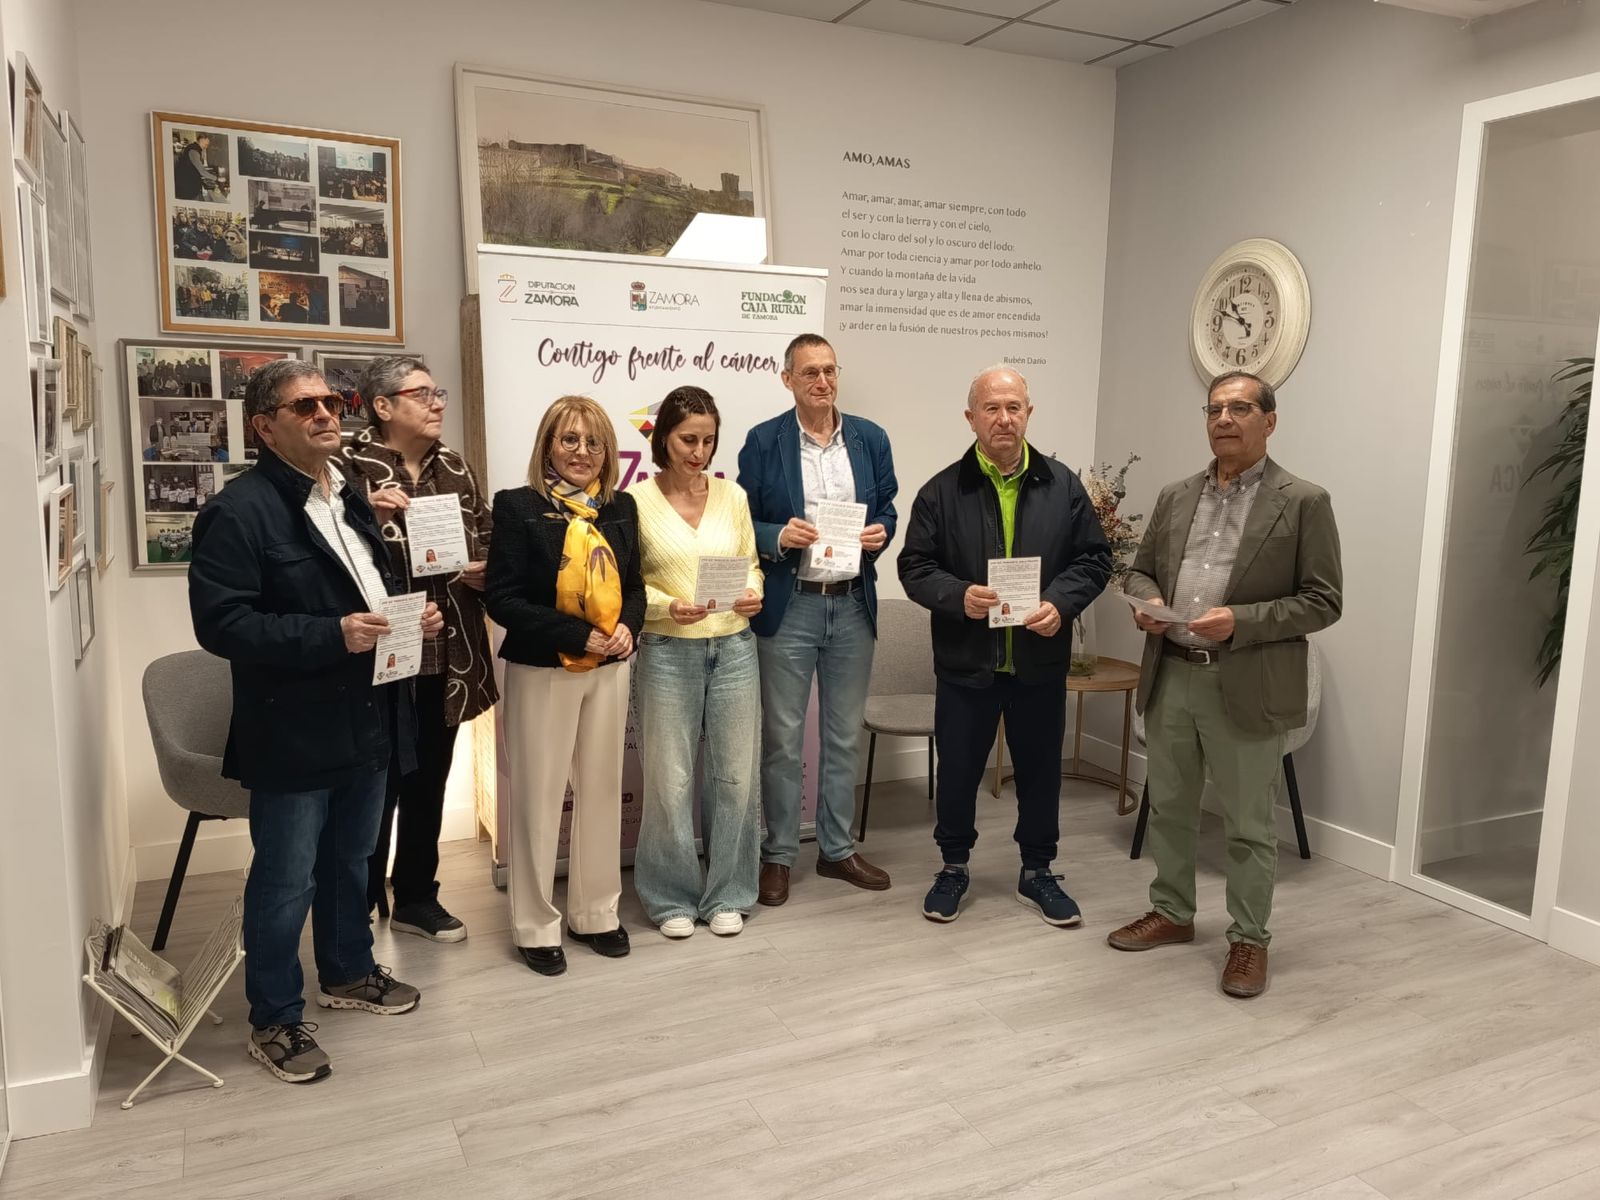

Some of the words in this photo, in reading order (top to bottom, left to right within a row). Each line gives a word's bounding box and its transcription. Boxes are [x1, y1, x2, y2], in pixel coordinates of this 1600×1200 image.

[876, 155, 911, 169] AMAS
[842, 191, 869, 203] Amar,
[870, 195, 896, 206] amar,
[898, 198, 922, 208] amar,
[924, 201, 946, 209] amar
[949, 202, 986, 215] siempre,
[988, 207, 1004, 215] con
[1006, 207, 1026, 217] todo
[842, 208, 850, 219] el
[853, 212, 868, 220] ser
[869, 214, 875, 223] y
[877, 214, 894, 223] con
[897, 213, 904, 224] la
[906, 216, 931, 227] tierra
[933, 219, 939, 230] y
[940, 220, 956, 229] con
[958, 220, 966, 229] el
[968, 222, 992, 233] cielo,
[841, 229, 859, 238] con
[862, 229, 870, 239] lo
[872, 230, 895, 241] claro
[898, 233, 911, 243] del
[914, 235, 926, 244] sol
[929, 238, 934, 247] y
[936, 236, 944, 246] lo
[946, 239, 976, 249] oscuro
[979, 241, 992, 250] del
[840, 248, 865, 257] Amar
[868, 250, 885, 261] por
[887, 251, 907, 261] toda
[909, 253, 941, 263] ciencia
[943, 258, 949, 266] y
[950, 257, 972, 266] amar
[974, 259, 989, 268] por
[991, 259, 1011, 268] todo
[1013, 260, 1042, 271] anhelo
[840, 265, 847, 275] Y
[849, 267, 883, 277] cuando
[886, 268, 893, 278] la
[895, 271, 934, 281] montaña
[936, 272, 947, 282] de
[950, 272, 956, 282] la
[958, 274, 976, 283] vida
[1240, 276, 1252, 294] 12
[524, 293, 579, 307] ZAMORA
[649, 291, 700, 306] ZAMORA
[840, 285, 857, 294] nos
[859, 287, 874, 295] sea
[877, 286, 897, 296] dura
[899, 290, 904, 299] y
[907, 288, 928, 300] larga
[930, 292, 935, 301] y
[937, 290, 952, 300] alta
[955, 293, 960, 303] y
[961, 291, 982, 302] llena
[984, 293, 994, 302] de
[996, 294, 1033, 306] abismos,
[1220, 297, 1228, 311] 10
[1263, 291, 1270, 306] 2
[741, 302, 768, 313] CAJA
[771, 304, 806, 315] RURAL
[840, 303, 863, 312] amar
[866, 303, 873, 312] la
[875, 304, 927, 315] inmensidad
[929, 309, 946, 318] que
[960, 309, 970, 318] de
[972, 311, 995, 319] amor
[997, 312, 1040, 321] encendida
[1212, 315, 1223, 333] 9
[1264, 310, 1275, 329] 3
[849, 320, 874, 330] arder
[890, 322, 896, 331] la
[899, 322, 925, 333] fusión
[928, 324, 939, 334] de
[941, 326, 978, 336] nuestros
[980, 328, 1011, 338] pechos
[1013, 329, 1048, 339] mismos!
[1003, 355, 1026, 364] Rubén
[1222, 346, 1231, 359] 7
[1235, 348, 1246, 366] 6
[1251, 344, 1258, 358] 5
[538, 337, 622, 384] Contigo
[627, 345, 687, 381] frente
[693, 342, 716, 372] al
[720, 352, 780, 375] cáncer
